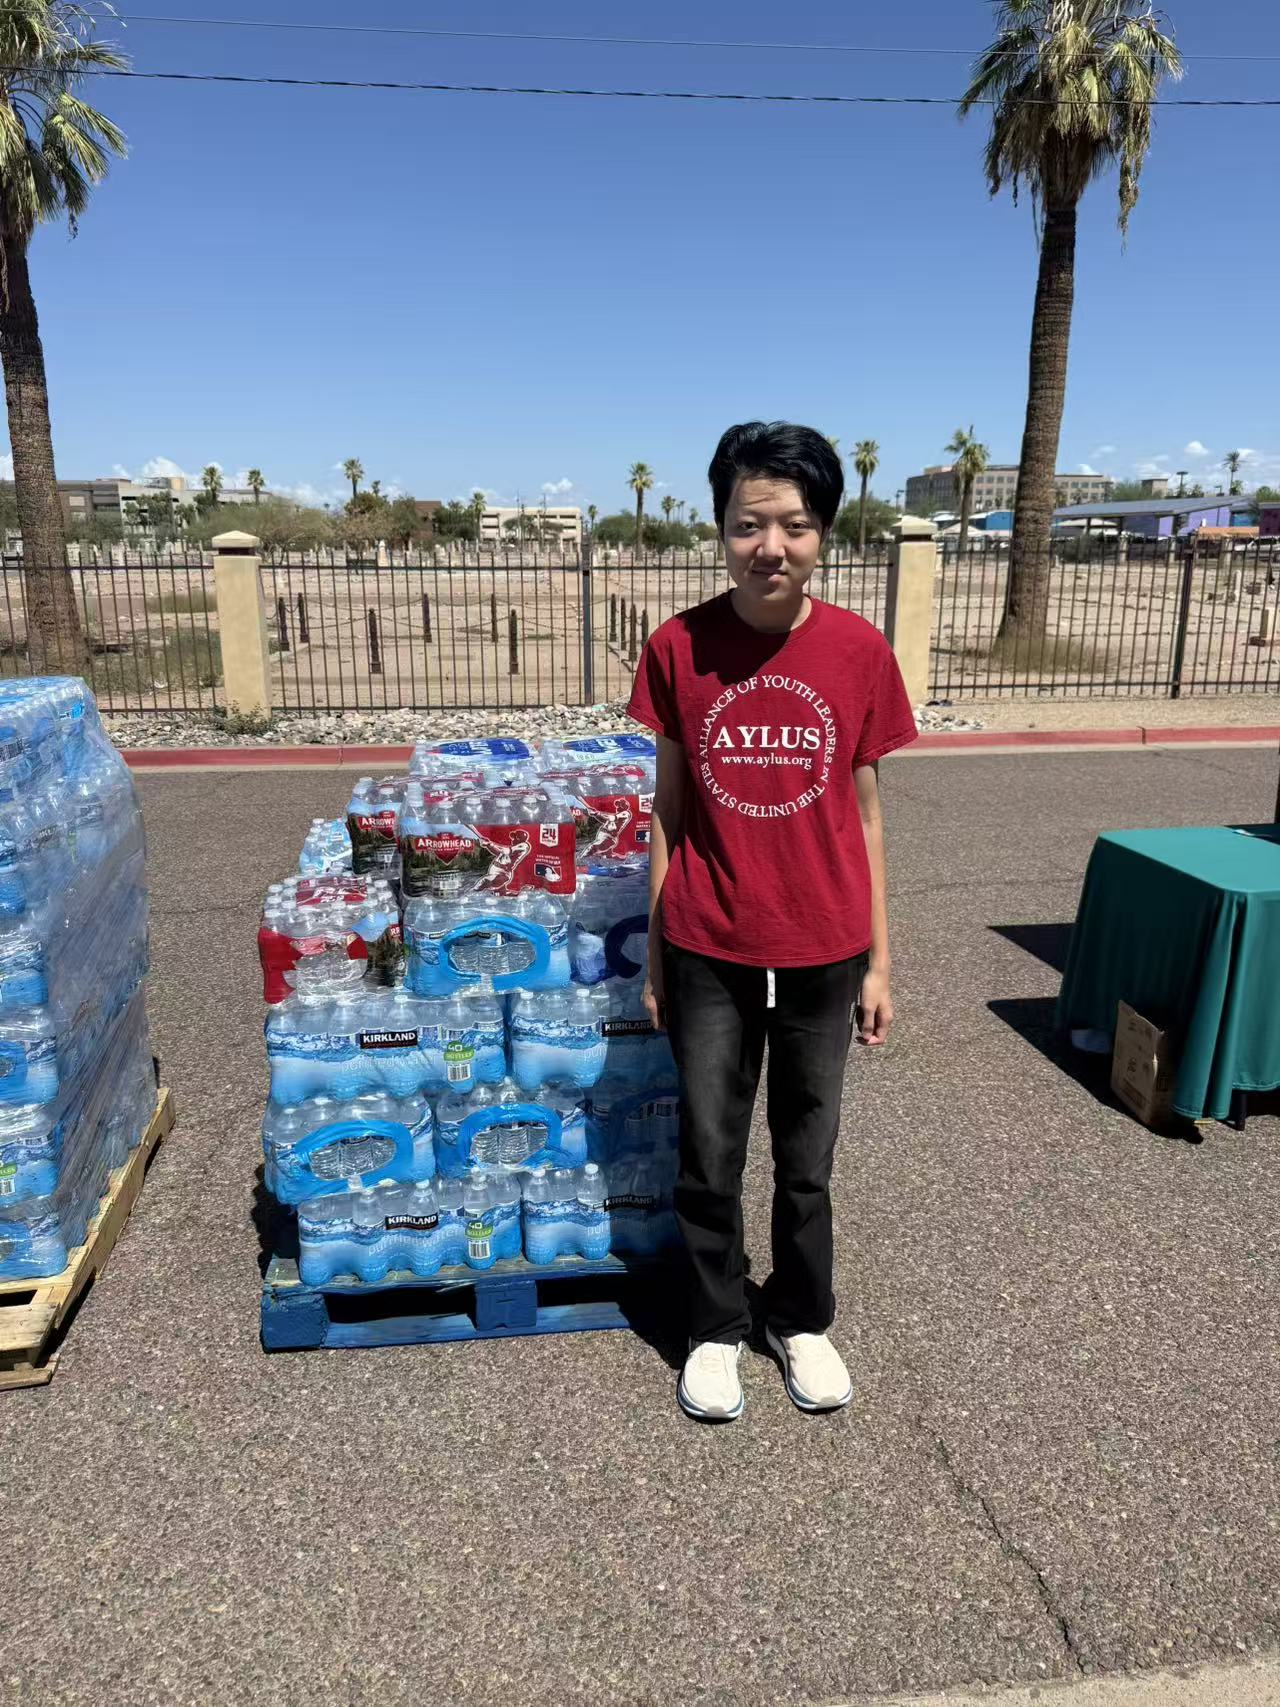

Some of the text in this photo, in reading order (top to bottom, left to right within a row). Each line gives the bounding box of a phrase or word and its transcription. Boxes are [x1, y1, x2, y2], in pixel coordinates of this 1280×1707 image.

[712, 726, 821, 750] AYLUS
[700, 675, 837, 818] ALLIANCE OF YOUTH LEADERS IN THE UNITED STATES
[721, 752, 812, 770] www.aylus.org
[542, 828, 556, 840] 24
[417, 838, 472, 849] ARROWHEAD
[363, 1032, 416, 1043] KIRKLAND
[388, 1215, 437, 1225] KIRKLAND
